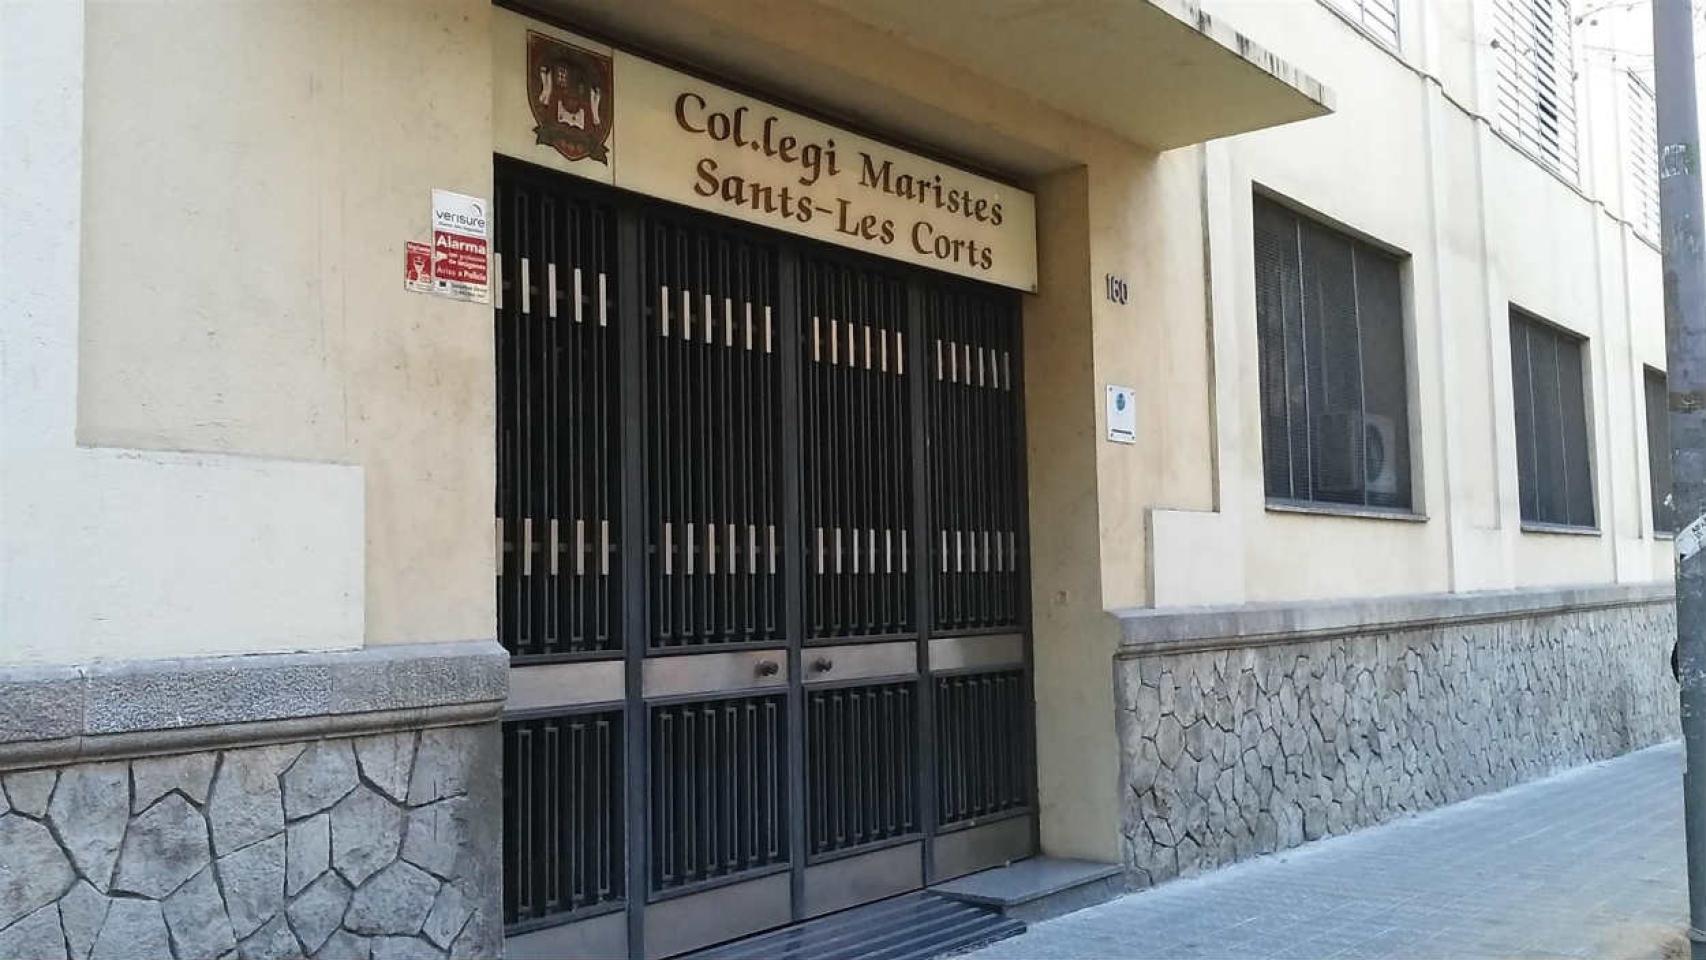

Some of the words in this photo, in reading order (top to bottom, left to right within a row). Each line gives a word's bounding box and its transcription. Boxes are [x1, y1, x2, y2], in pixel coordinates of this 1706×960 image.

[675, 92, 840, 186] Col.legi
[858, 152, 1003, 226] Maristes
[436, 210, 486, 227] verisure
[694, 158, 895, 244] Sants-Les
[911, 221, 993, 270] Corts
[436, 235, 486, 254] Alarma
[1106, 273, 1128, 305] 160
